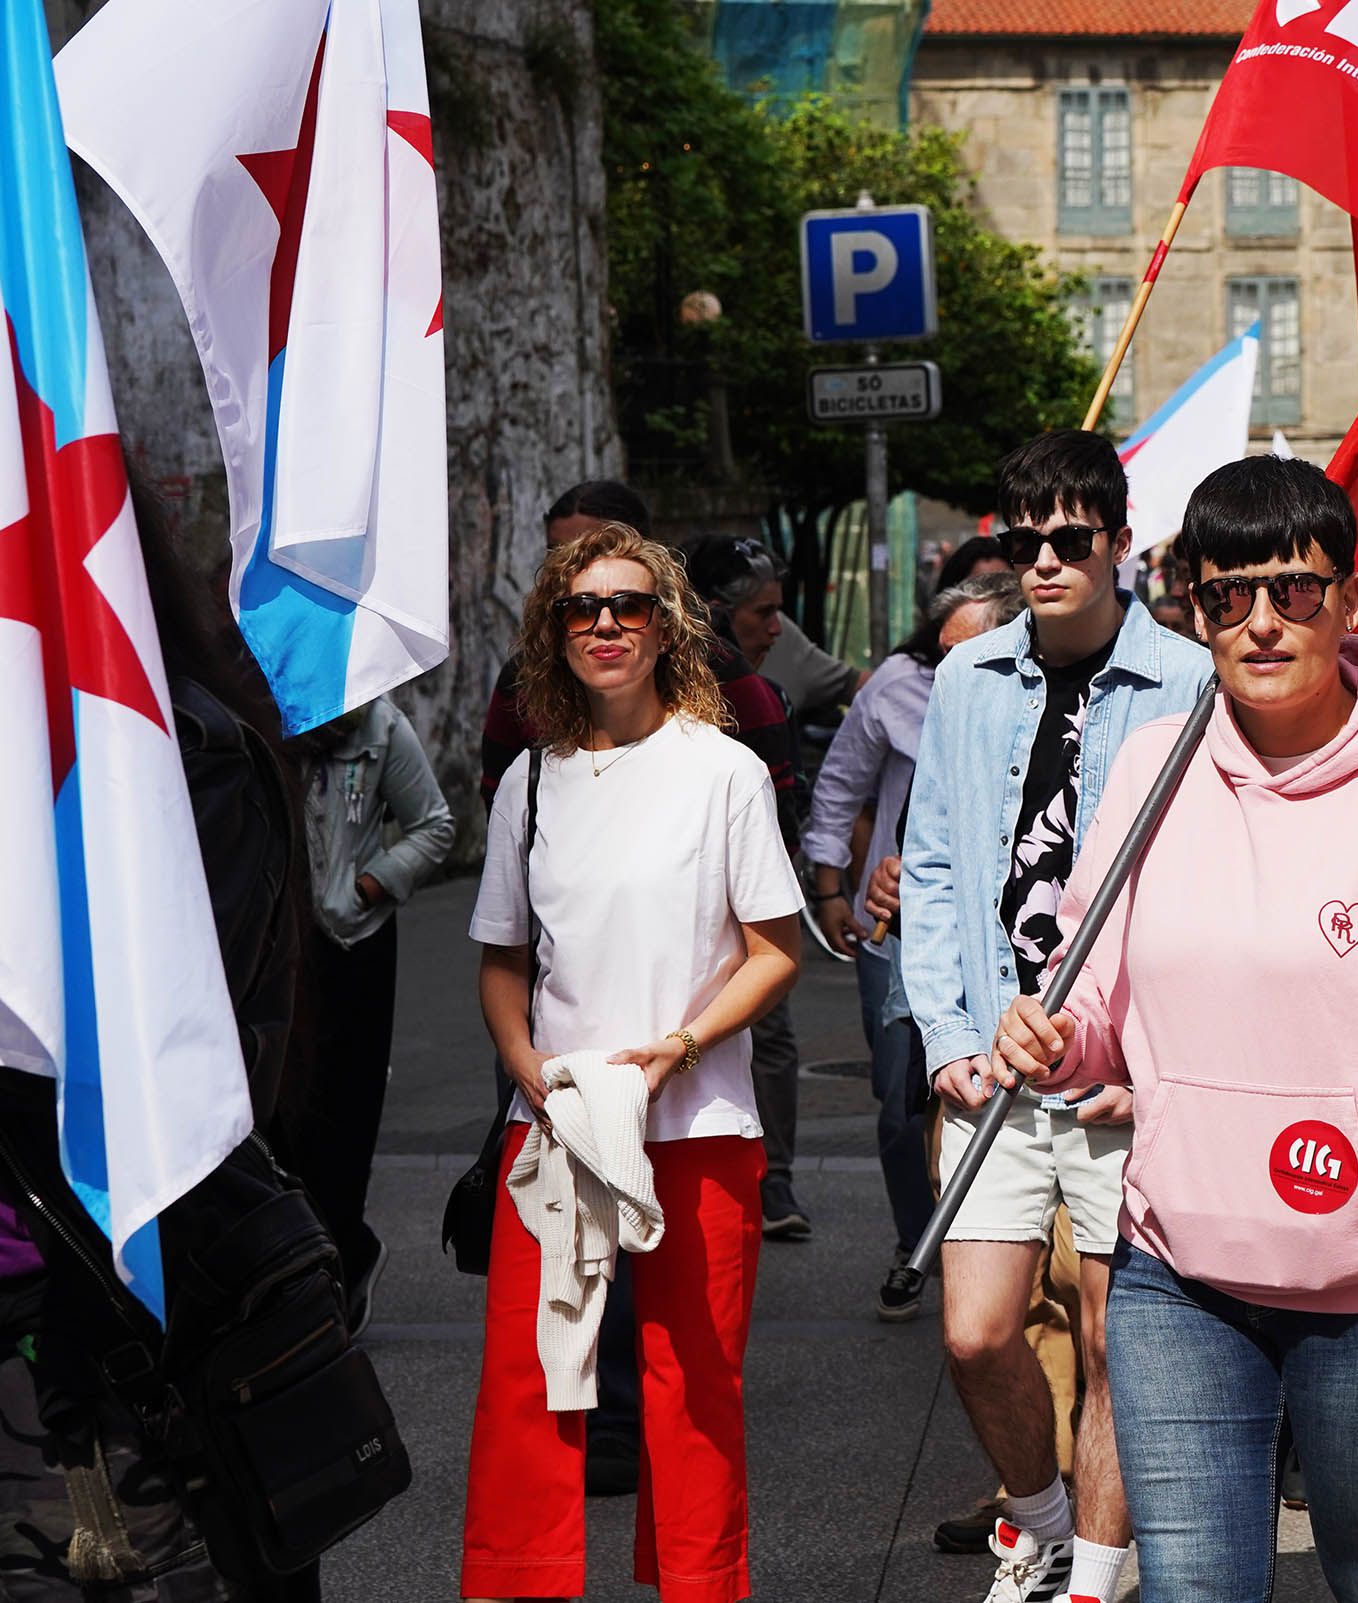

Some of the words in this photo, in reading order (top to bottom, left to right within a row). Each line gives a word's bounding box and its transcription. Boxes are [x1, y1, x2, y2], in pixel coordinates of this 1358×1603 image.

[1236, 42, 1335, 65] Confederación
[830, 231, 898, 325] P
[818, 394, 922, 414] BICICLETAS
[1288, 1138, 1342, 1180] CIG
[355, 1438, 382, 1462] LOIS
